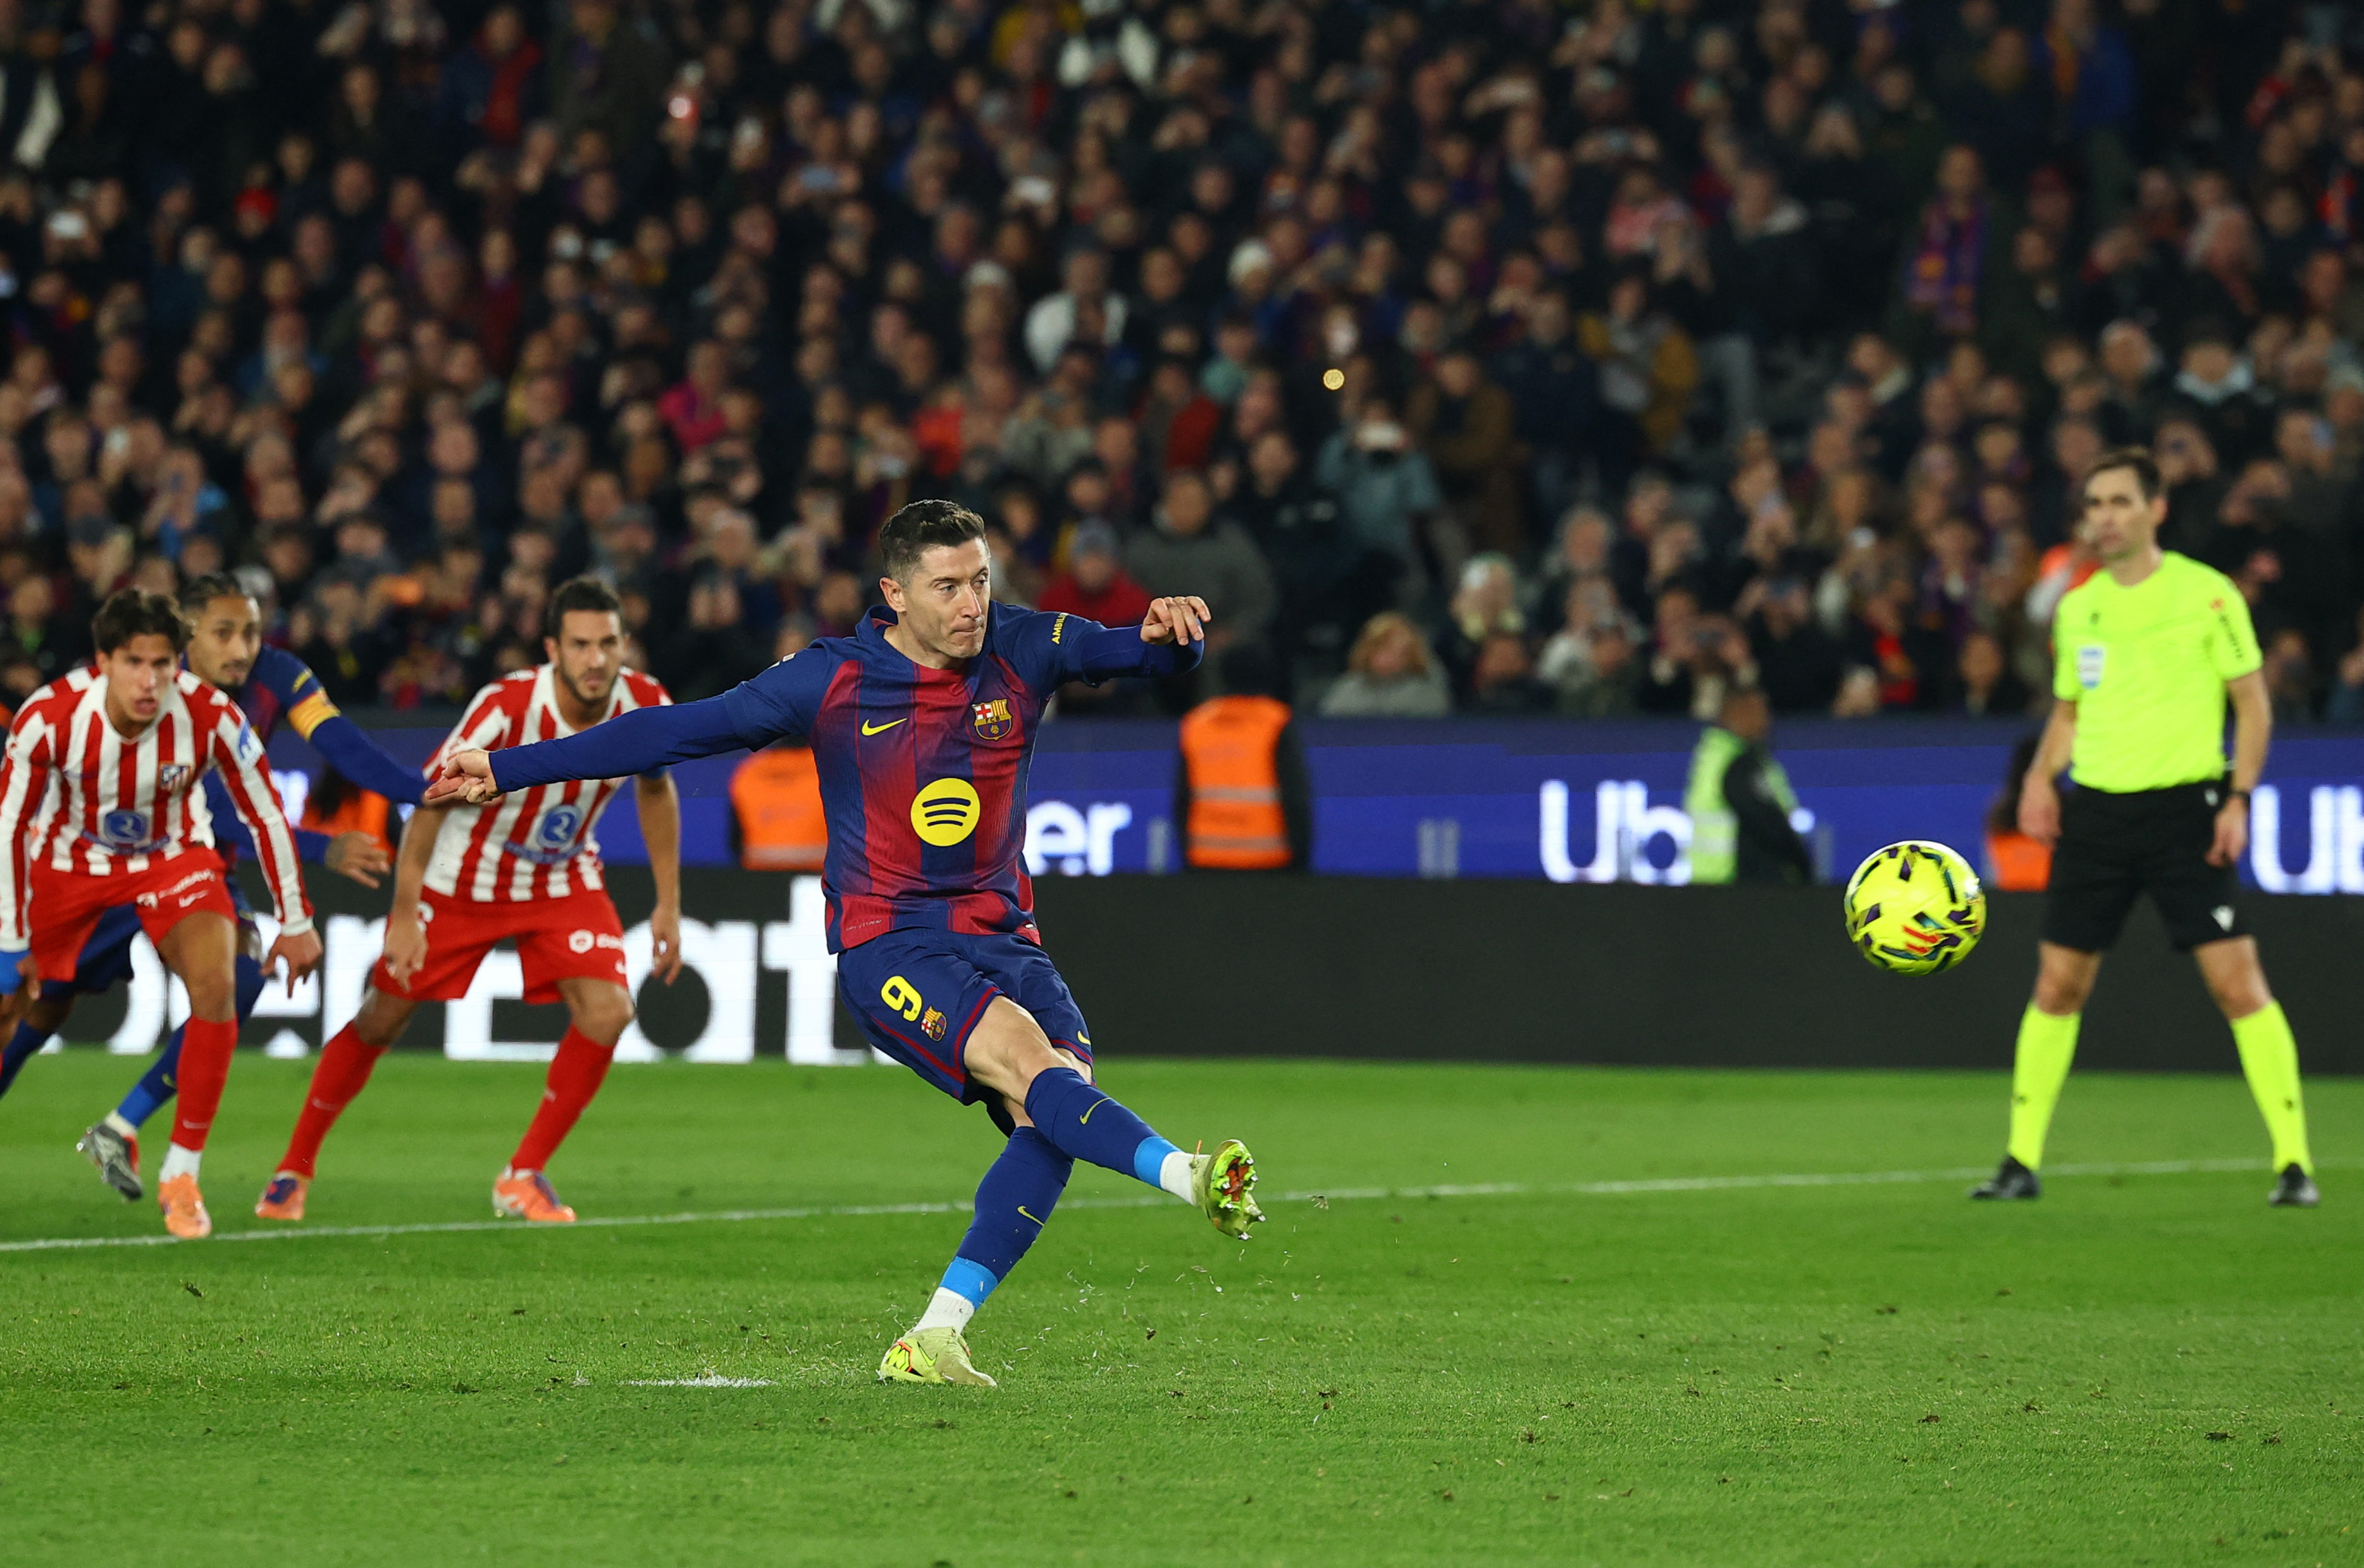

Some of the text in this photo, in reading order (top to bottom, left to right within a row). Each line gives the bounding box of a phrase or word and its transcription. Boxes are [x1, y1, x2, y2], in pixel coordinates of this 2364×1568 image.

[1051, 612, 1069, 645] AMBILI
[1023, 800, 1132, 877] er
[1539, 779, 1694, 885] Ub
[445, 875, 886, 1065] at
[881, 975, 922, 1022] 9
